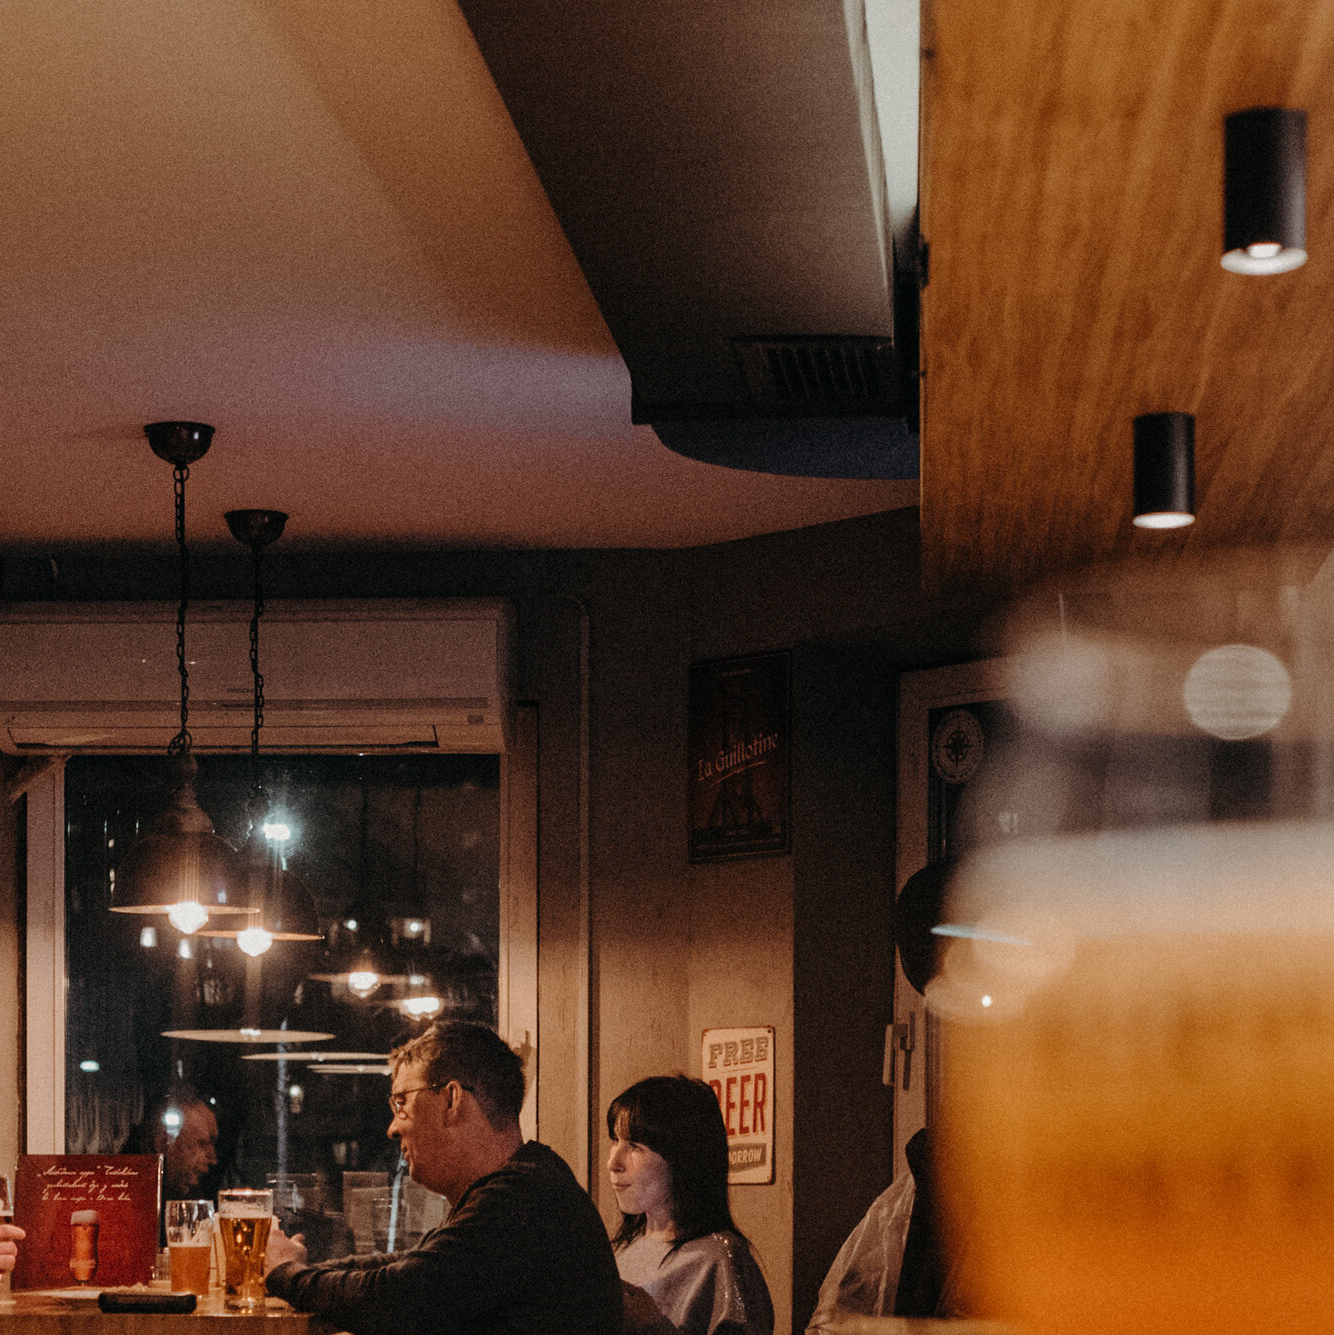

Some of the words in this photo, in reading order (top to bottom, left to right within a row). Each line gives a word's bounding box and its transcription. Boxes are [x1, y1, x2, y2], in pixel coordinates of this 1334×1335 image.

[698, 758, 713, 781] La
[715, 732, 778, 772] Guillotine
[708, 1036, 769, 1069] FREE
[729, 1148, 763, 1166] ORROW
